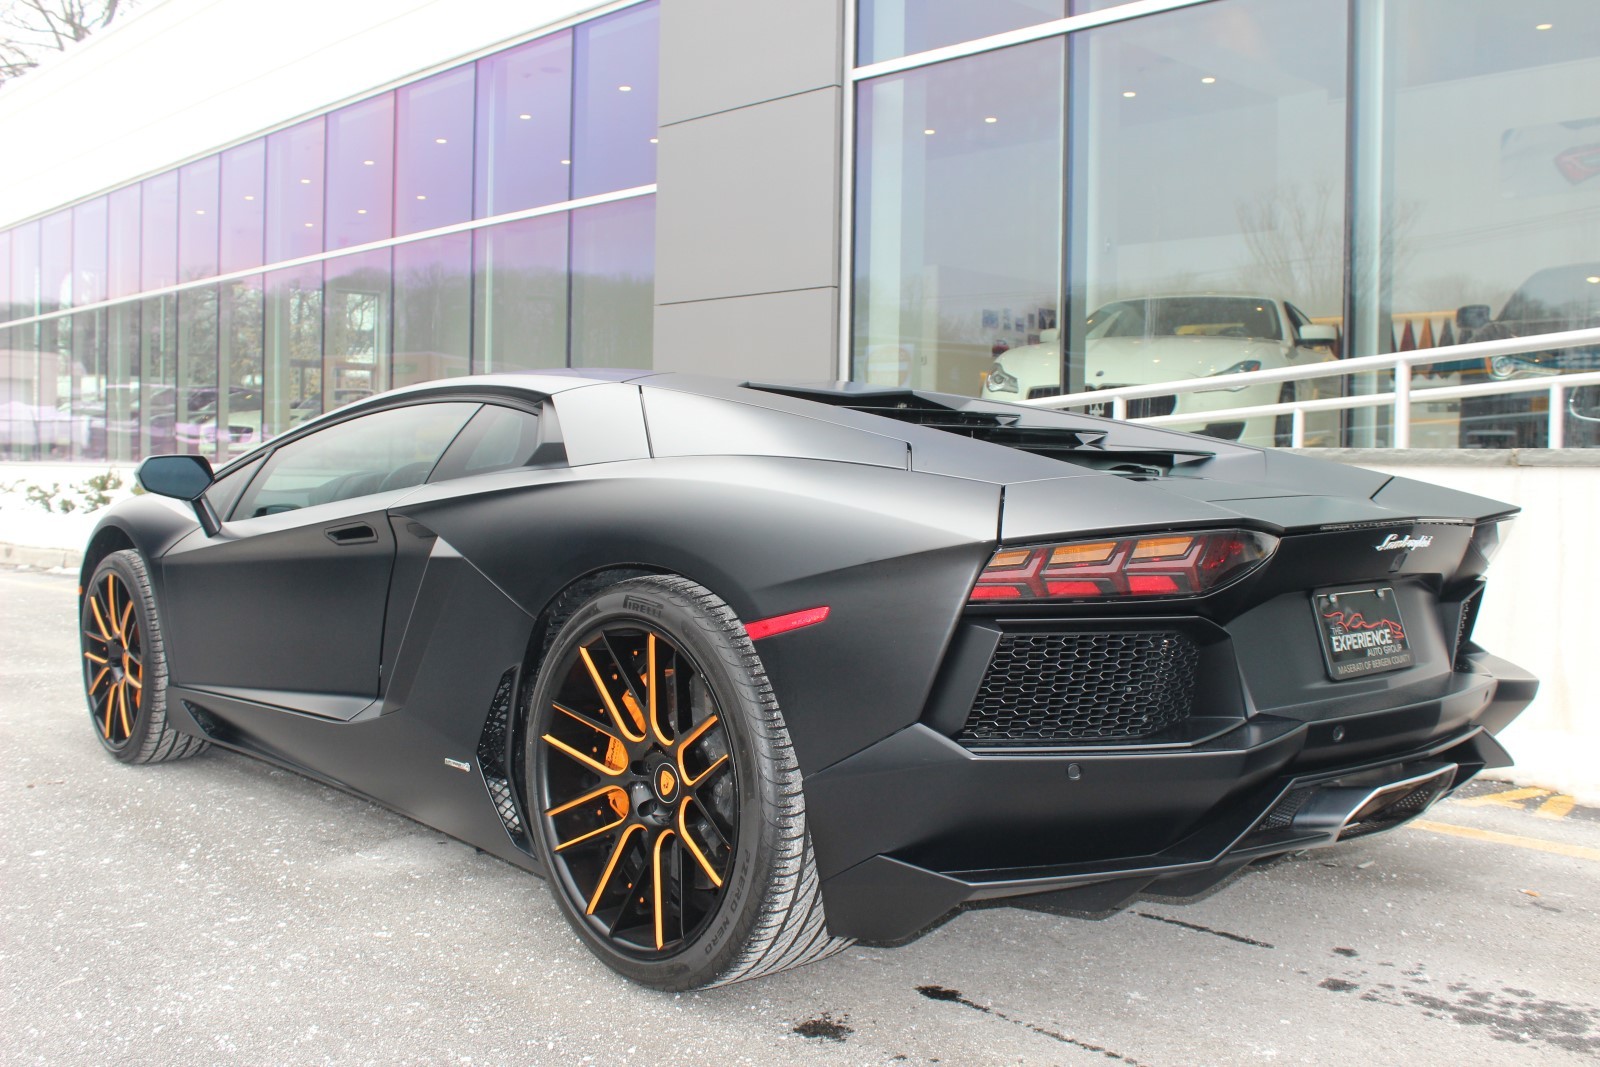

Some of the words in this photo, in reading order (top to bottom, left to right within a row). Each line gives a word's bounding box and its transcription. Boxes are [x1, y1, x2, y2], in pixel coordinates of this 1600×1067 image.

[623, 594, 664, 618] PIRELLI
[1331, 627, 1343, 635] THE
[1332, 628, 1392, 652] EXPERIENCE
[1367, 647, 1382, 657] AUTO
[1383, 644, 1402, 654] GROUP
[1338, 662, 1364, 675] MASERATI
[1364, 662, 1372, 670] OF
[1372, 658, 1391, 669] BERGEN
[1391, 655, 1410, 665] COUNTY
